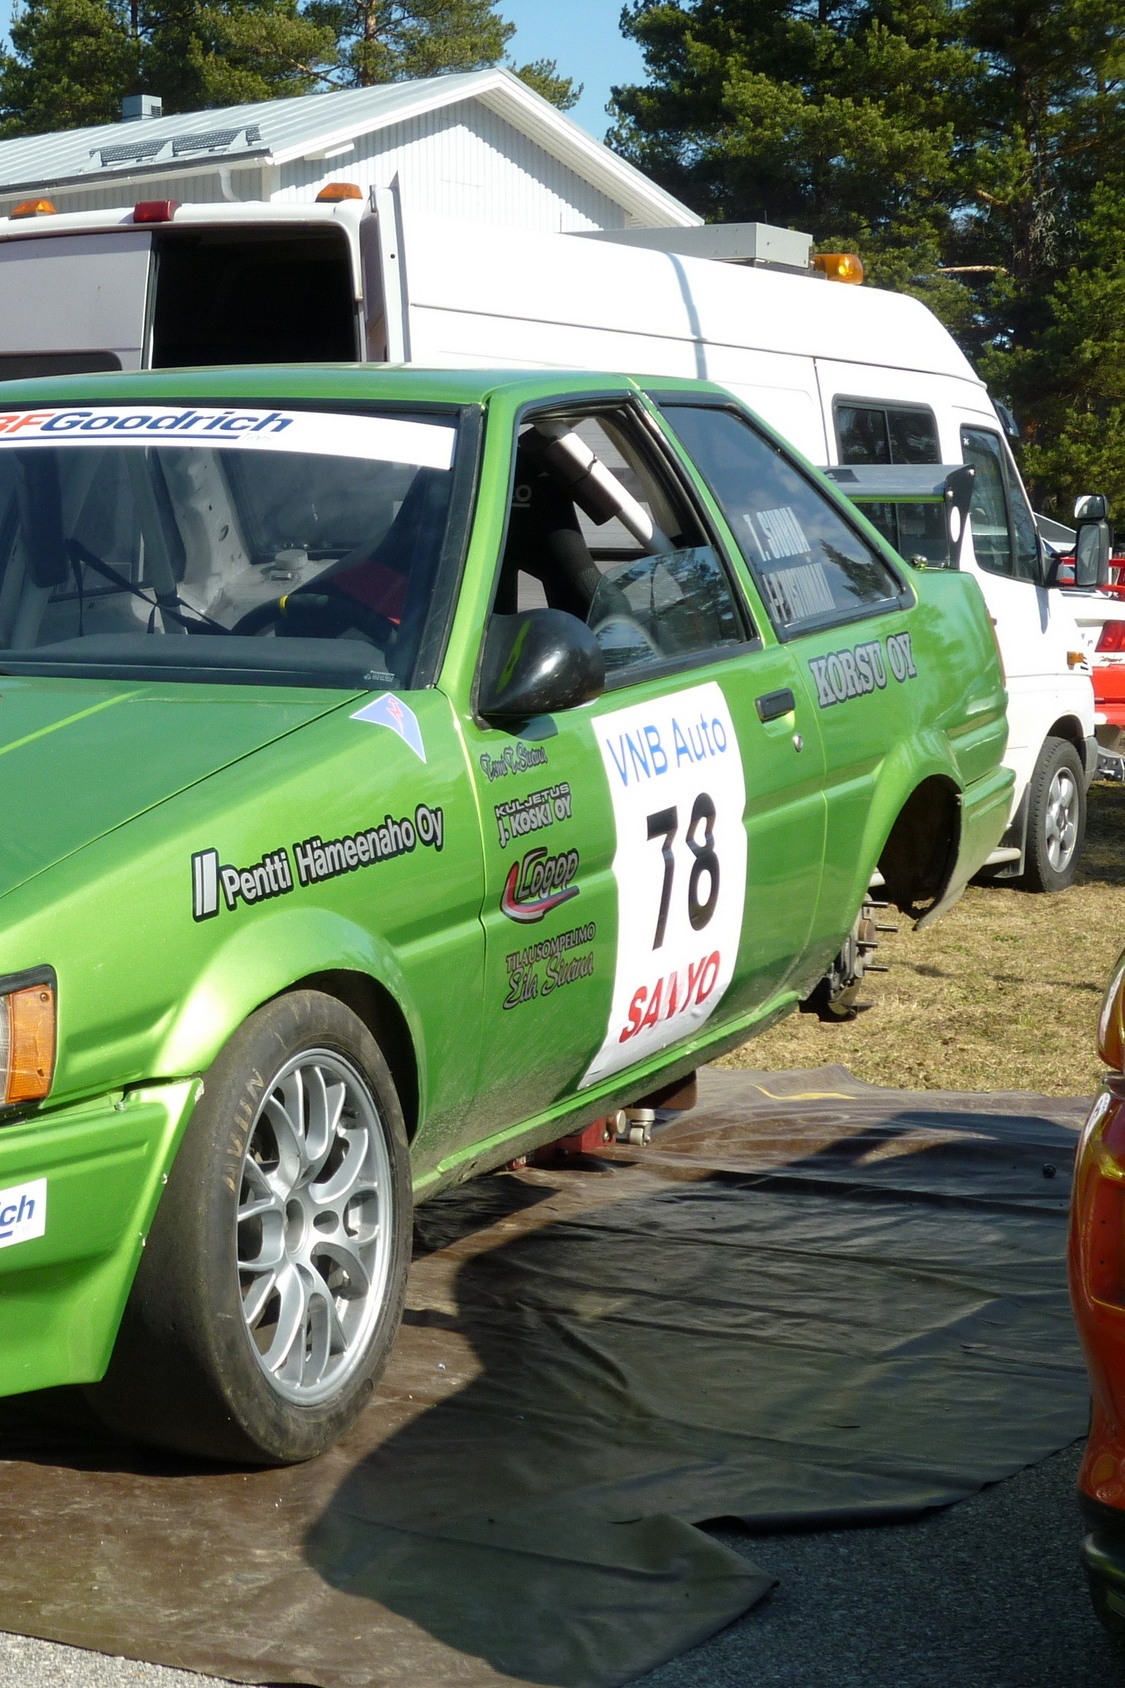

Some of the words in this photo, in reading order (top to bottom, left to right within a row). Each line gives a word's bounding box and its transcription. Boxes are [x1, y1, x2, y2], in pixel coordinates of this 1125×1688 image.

[808, 640, 887, 709] KORSU
[886, 631, 918, 682] OY
[606, 724, 669, 787] VNB
[672, 717, 728, 768] Auto
[495, 782, 570, 818] KULJETUS
[497, 819, 510, 848] J.
[509, 802, 554, 838] KOSKI
[554, 795, 572, 821] OY
[220, 847, 294, 911] Pentti
[293, 815, 416, 887] Hämeenaho
[415, 803, 443, 851] Oy
[647, 792, 720, 951] 78
[506, 921, 597, 974] TILAUSOMPELIMO
